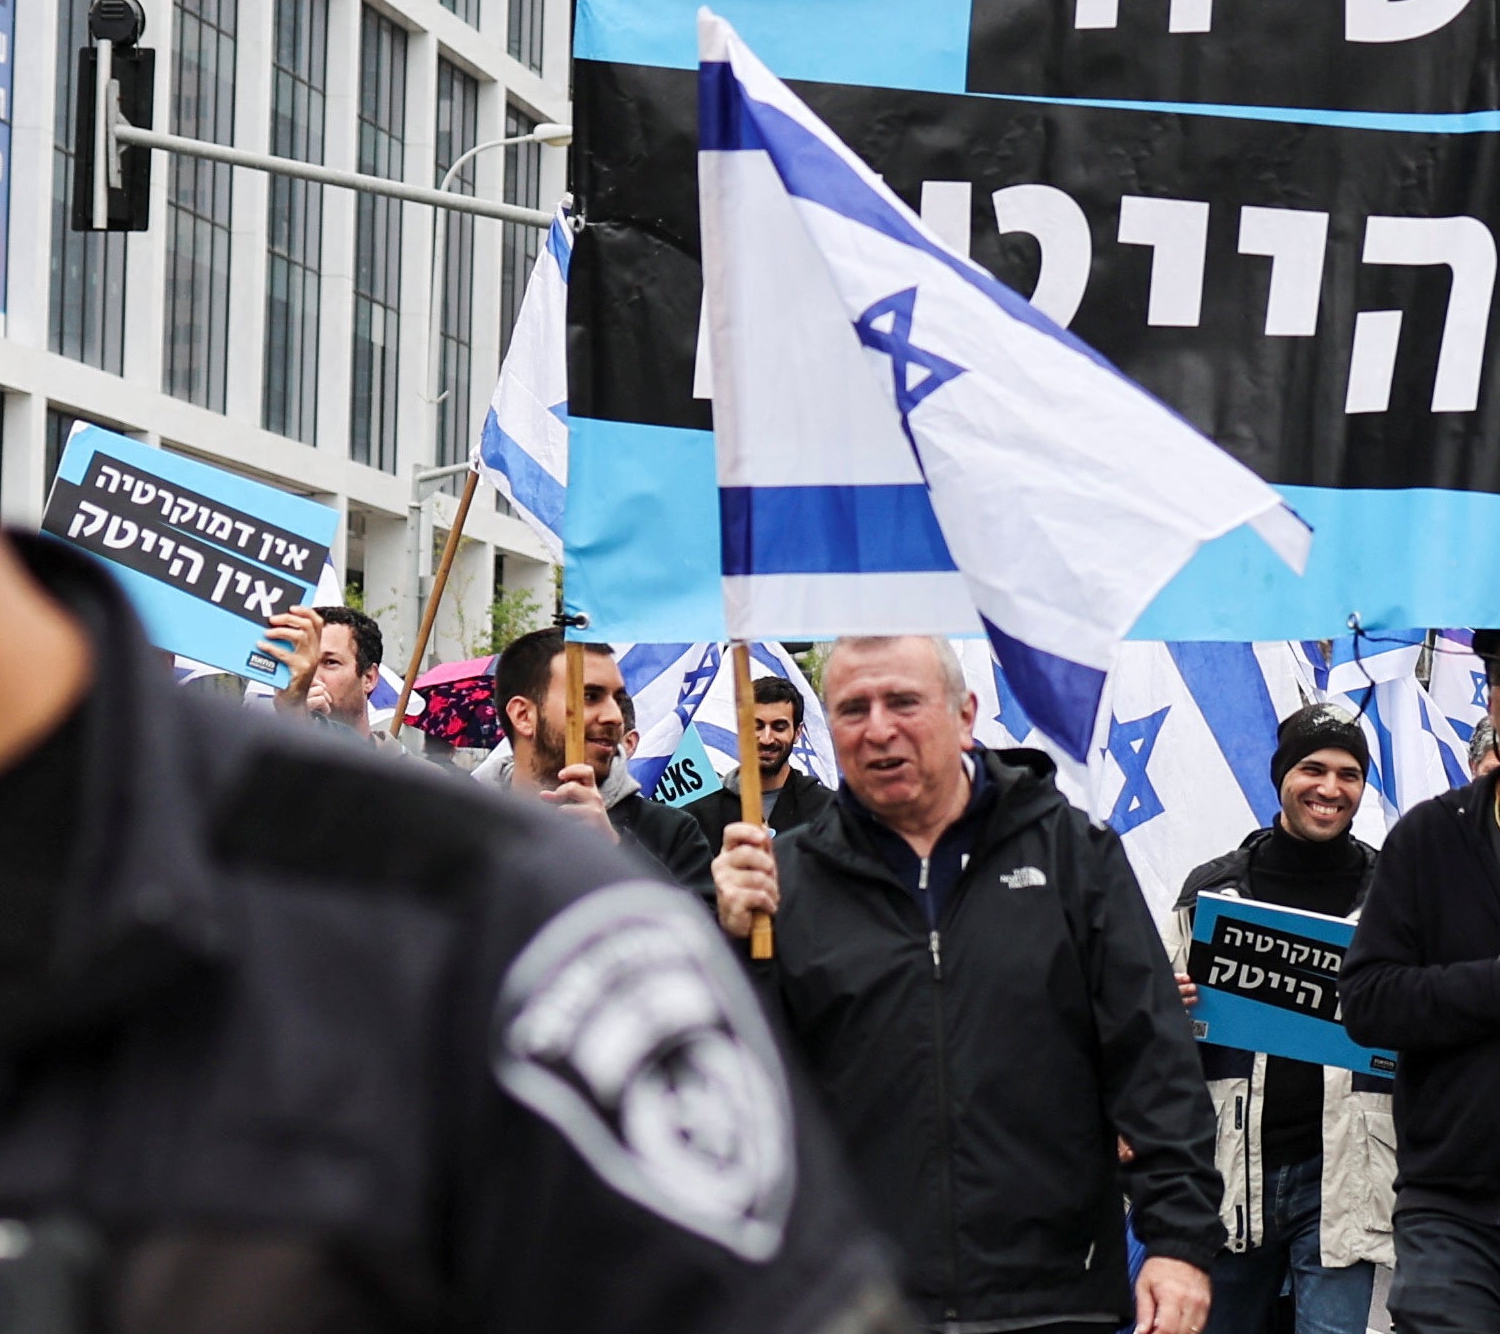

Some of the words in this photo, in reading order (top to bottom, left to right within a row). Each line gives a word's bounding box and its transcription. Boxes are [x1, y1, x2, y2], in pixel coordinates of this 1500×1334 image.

[693, 179, 1498, 414] הייט
[94, 465, 256, 548] דמוקרטיה
[66, 500, 206, 585] הייטק
[258, 531, 310, 572] אין
[210, 562, 284, 618] אין
[1223, 926, 1343, 972] מוקרטיה
[1207, 955, 1324, 1009] הייטק
